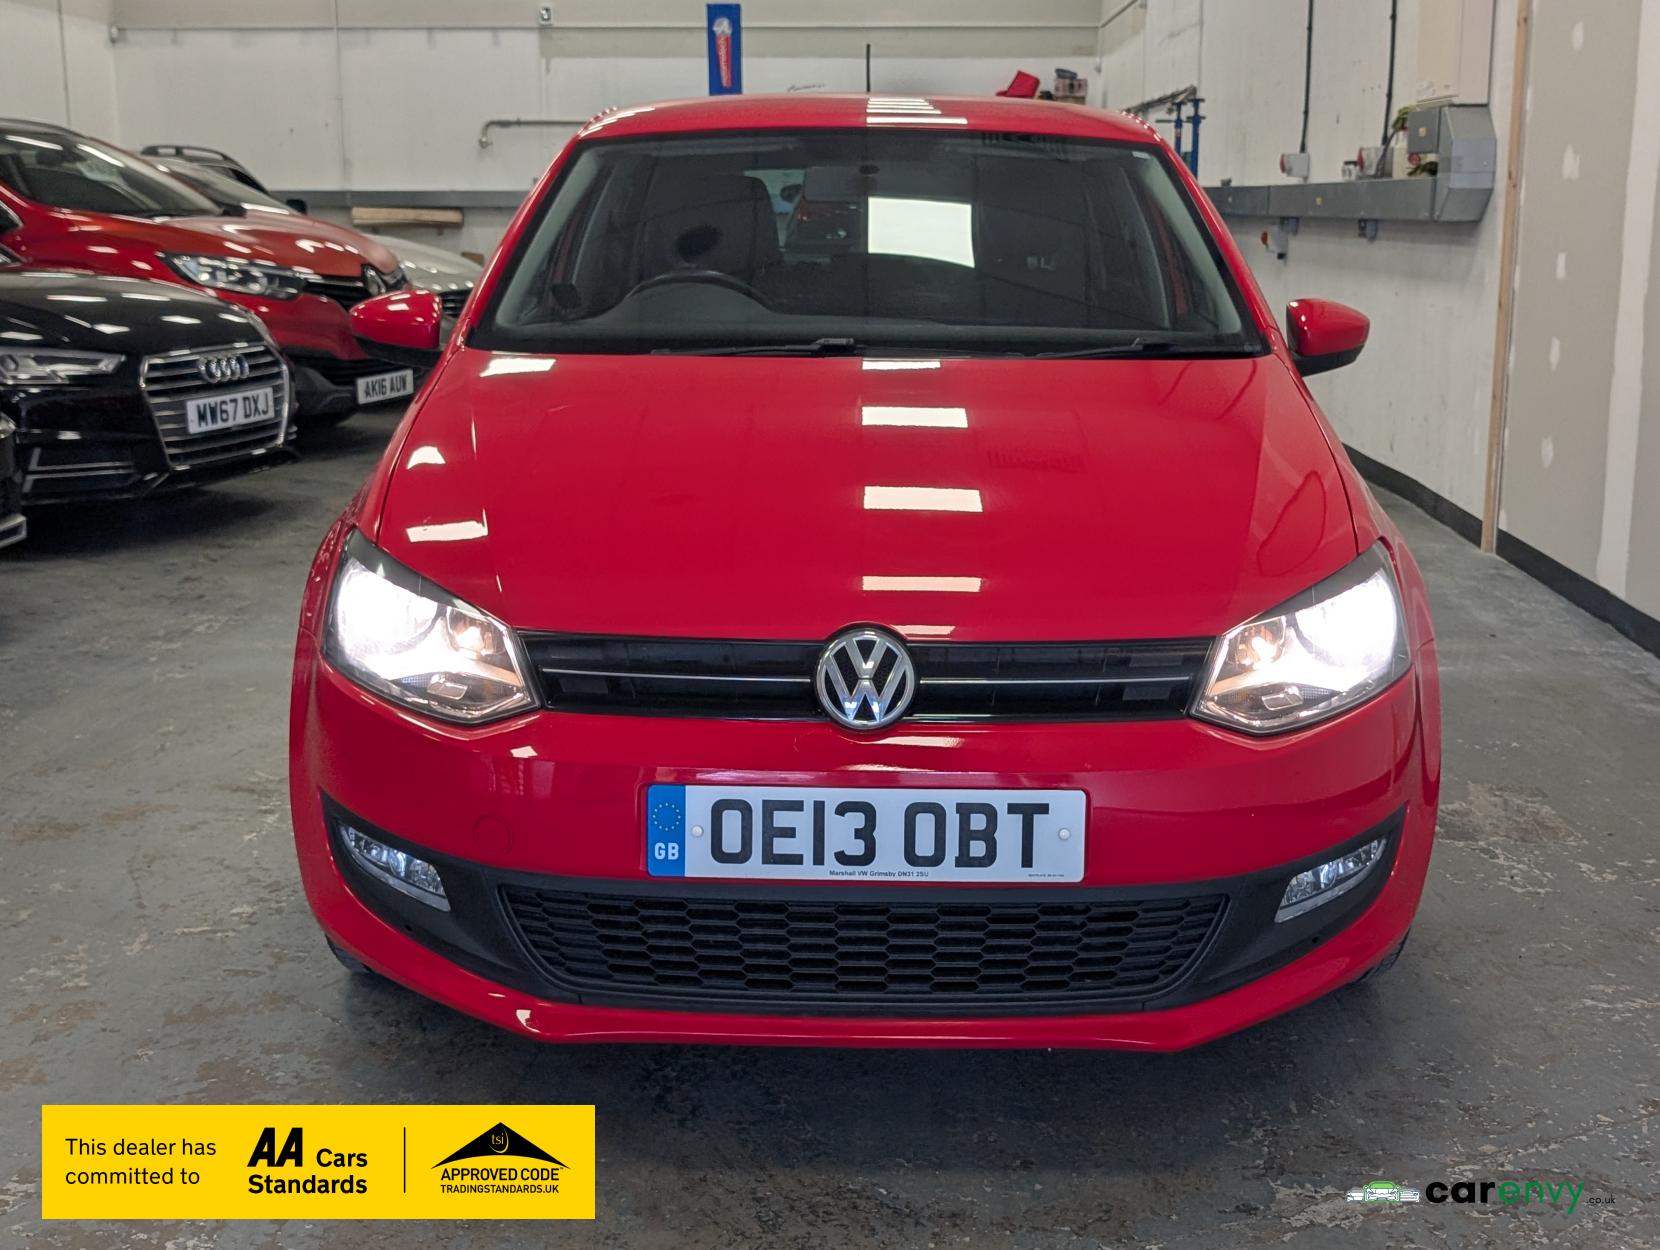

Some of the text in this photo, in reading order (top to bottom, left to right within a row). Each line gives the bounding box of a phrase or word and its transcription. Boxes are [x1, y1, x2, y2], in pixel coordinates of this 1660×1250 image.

[364, 377, 387, 399] AK16
[196, 392, 270, 427] MW67 DXJ
[711, 799, 1050, 868] OE13 OBT
[654, 842, 679, 860] GB
[829, 869, 856, 877] Marshall
[857, 869, 868, 877] VW
[869, 870, 896, 879] Grimsby
[897, 870, 914, 878] DN31
